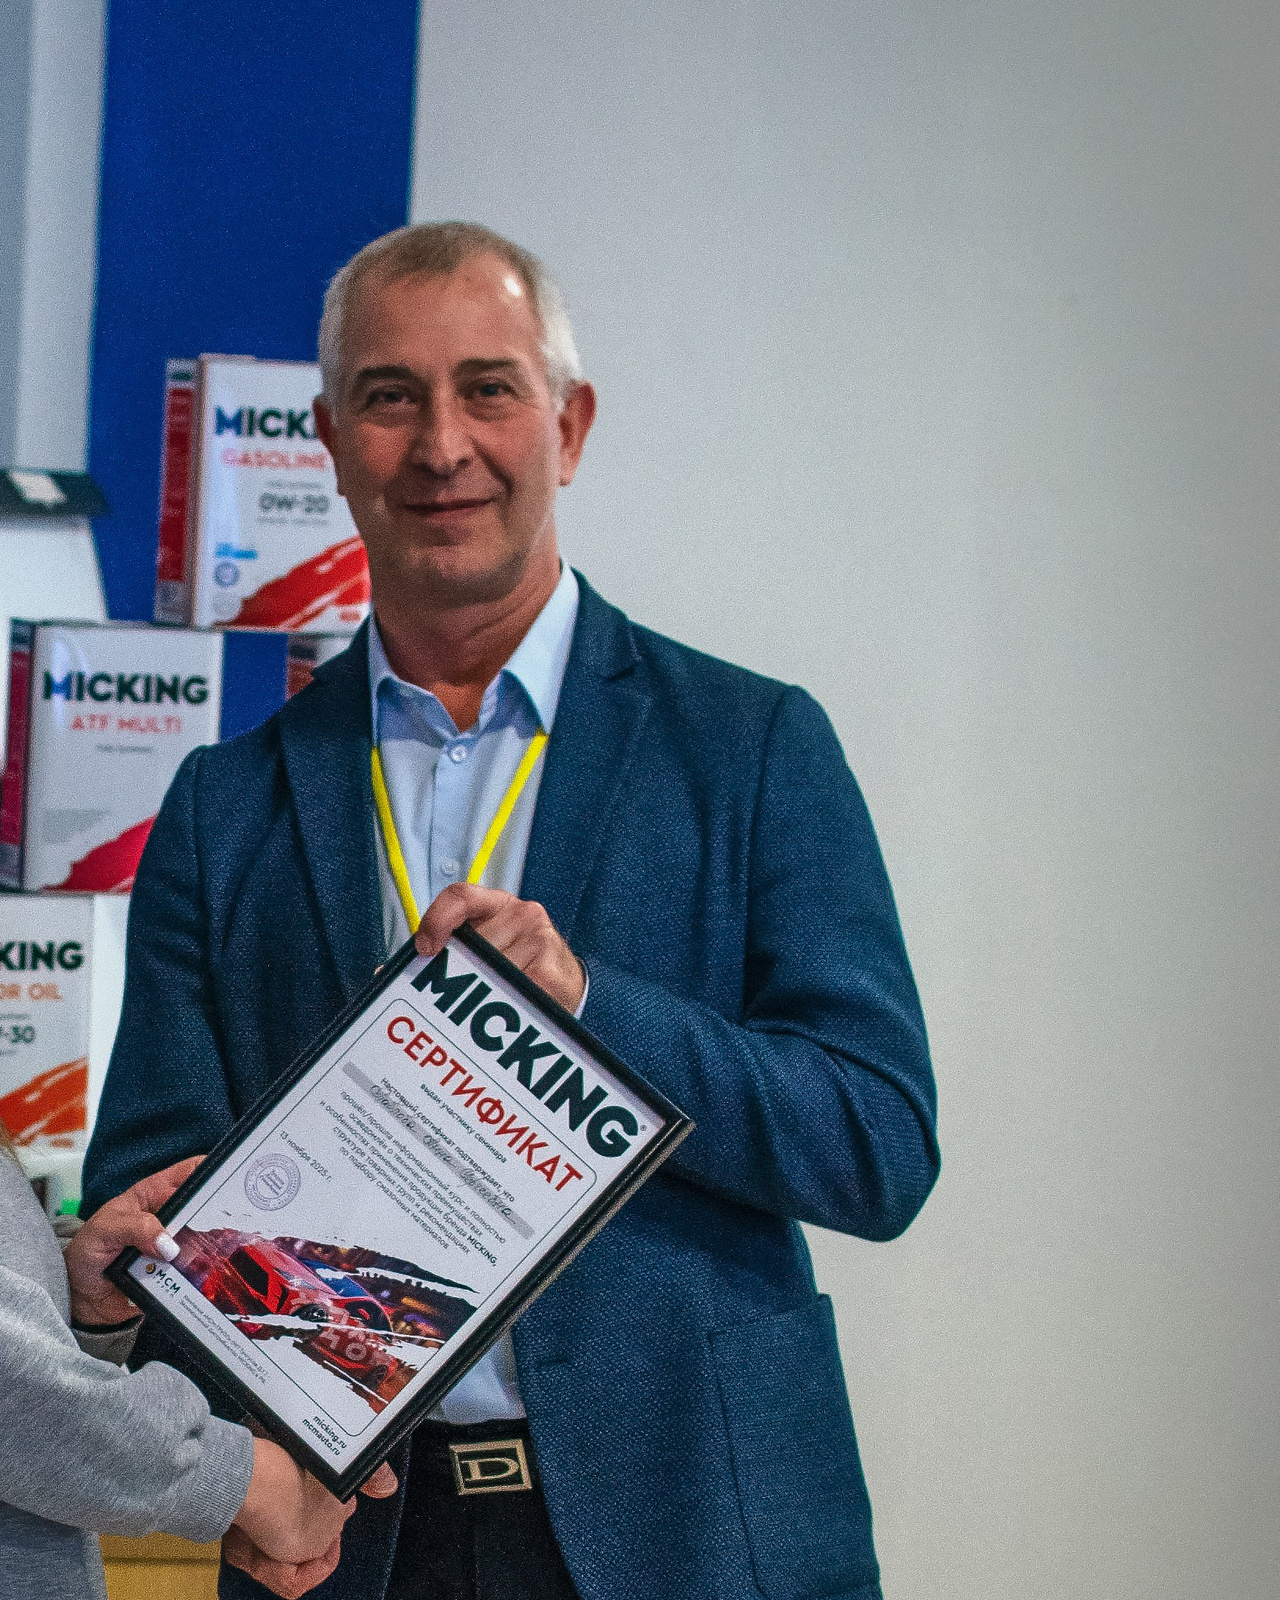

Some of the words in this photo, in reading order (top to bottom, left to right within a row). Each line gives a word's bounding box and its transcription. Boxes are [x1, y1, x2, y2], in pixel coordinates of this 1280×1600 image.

[214, 406, 318, 439] MICK
[43, 671, 209, 704] MICKING
[70, 714, 111, 731] ATF
[118, 716, 183, 734] MULTI
[27, 982, 63, 1001] OIL
[410, 947, 639, 1159] MICKING
[380, 1077, 419, 1113] Настоящий
[416, 1111, 456, 1147] сертификат
[386, 1016, 584, 1192] СЕРТИФИКАТ
[420, 1083, 442, 1104] выдан
[439, 1102, 476, 1135] участнику
[474, 1132, 507, 1164] семинара
[286, 1138, 312, 1162] ноября
[309, 1159, 328, 1177] 2025
[325, 1105, 370, 1147] особенностях
[368, 1145, 409, 1183] применения
[442, 1212, 468, 1238] бренда
[466, 1234, 498, 1267] MICKING,
[348, 1154, 378, 1183] подбору
[376, 1180, 411, 1214] смазочных
[410, 1212, 449, 1250] материалов
[301, 1418, 341, 1456] mcmauto.ru
[312, 1415, 348, 1449] micking.ru
